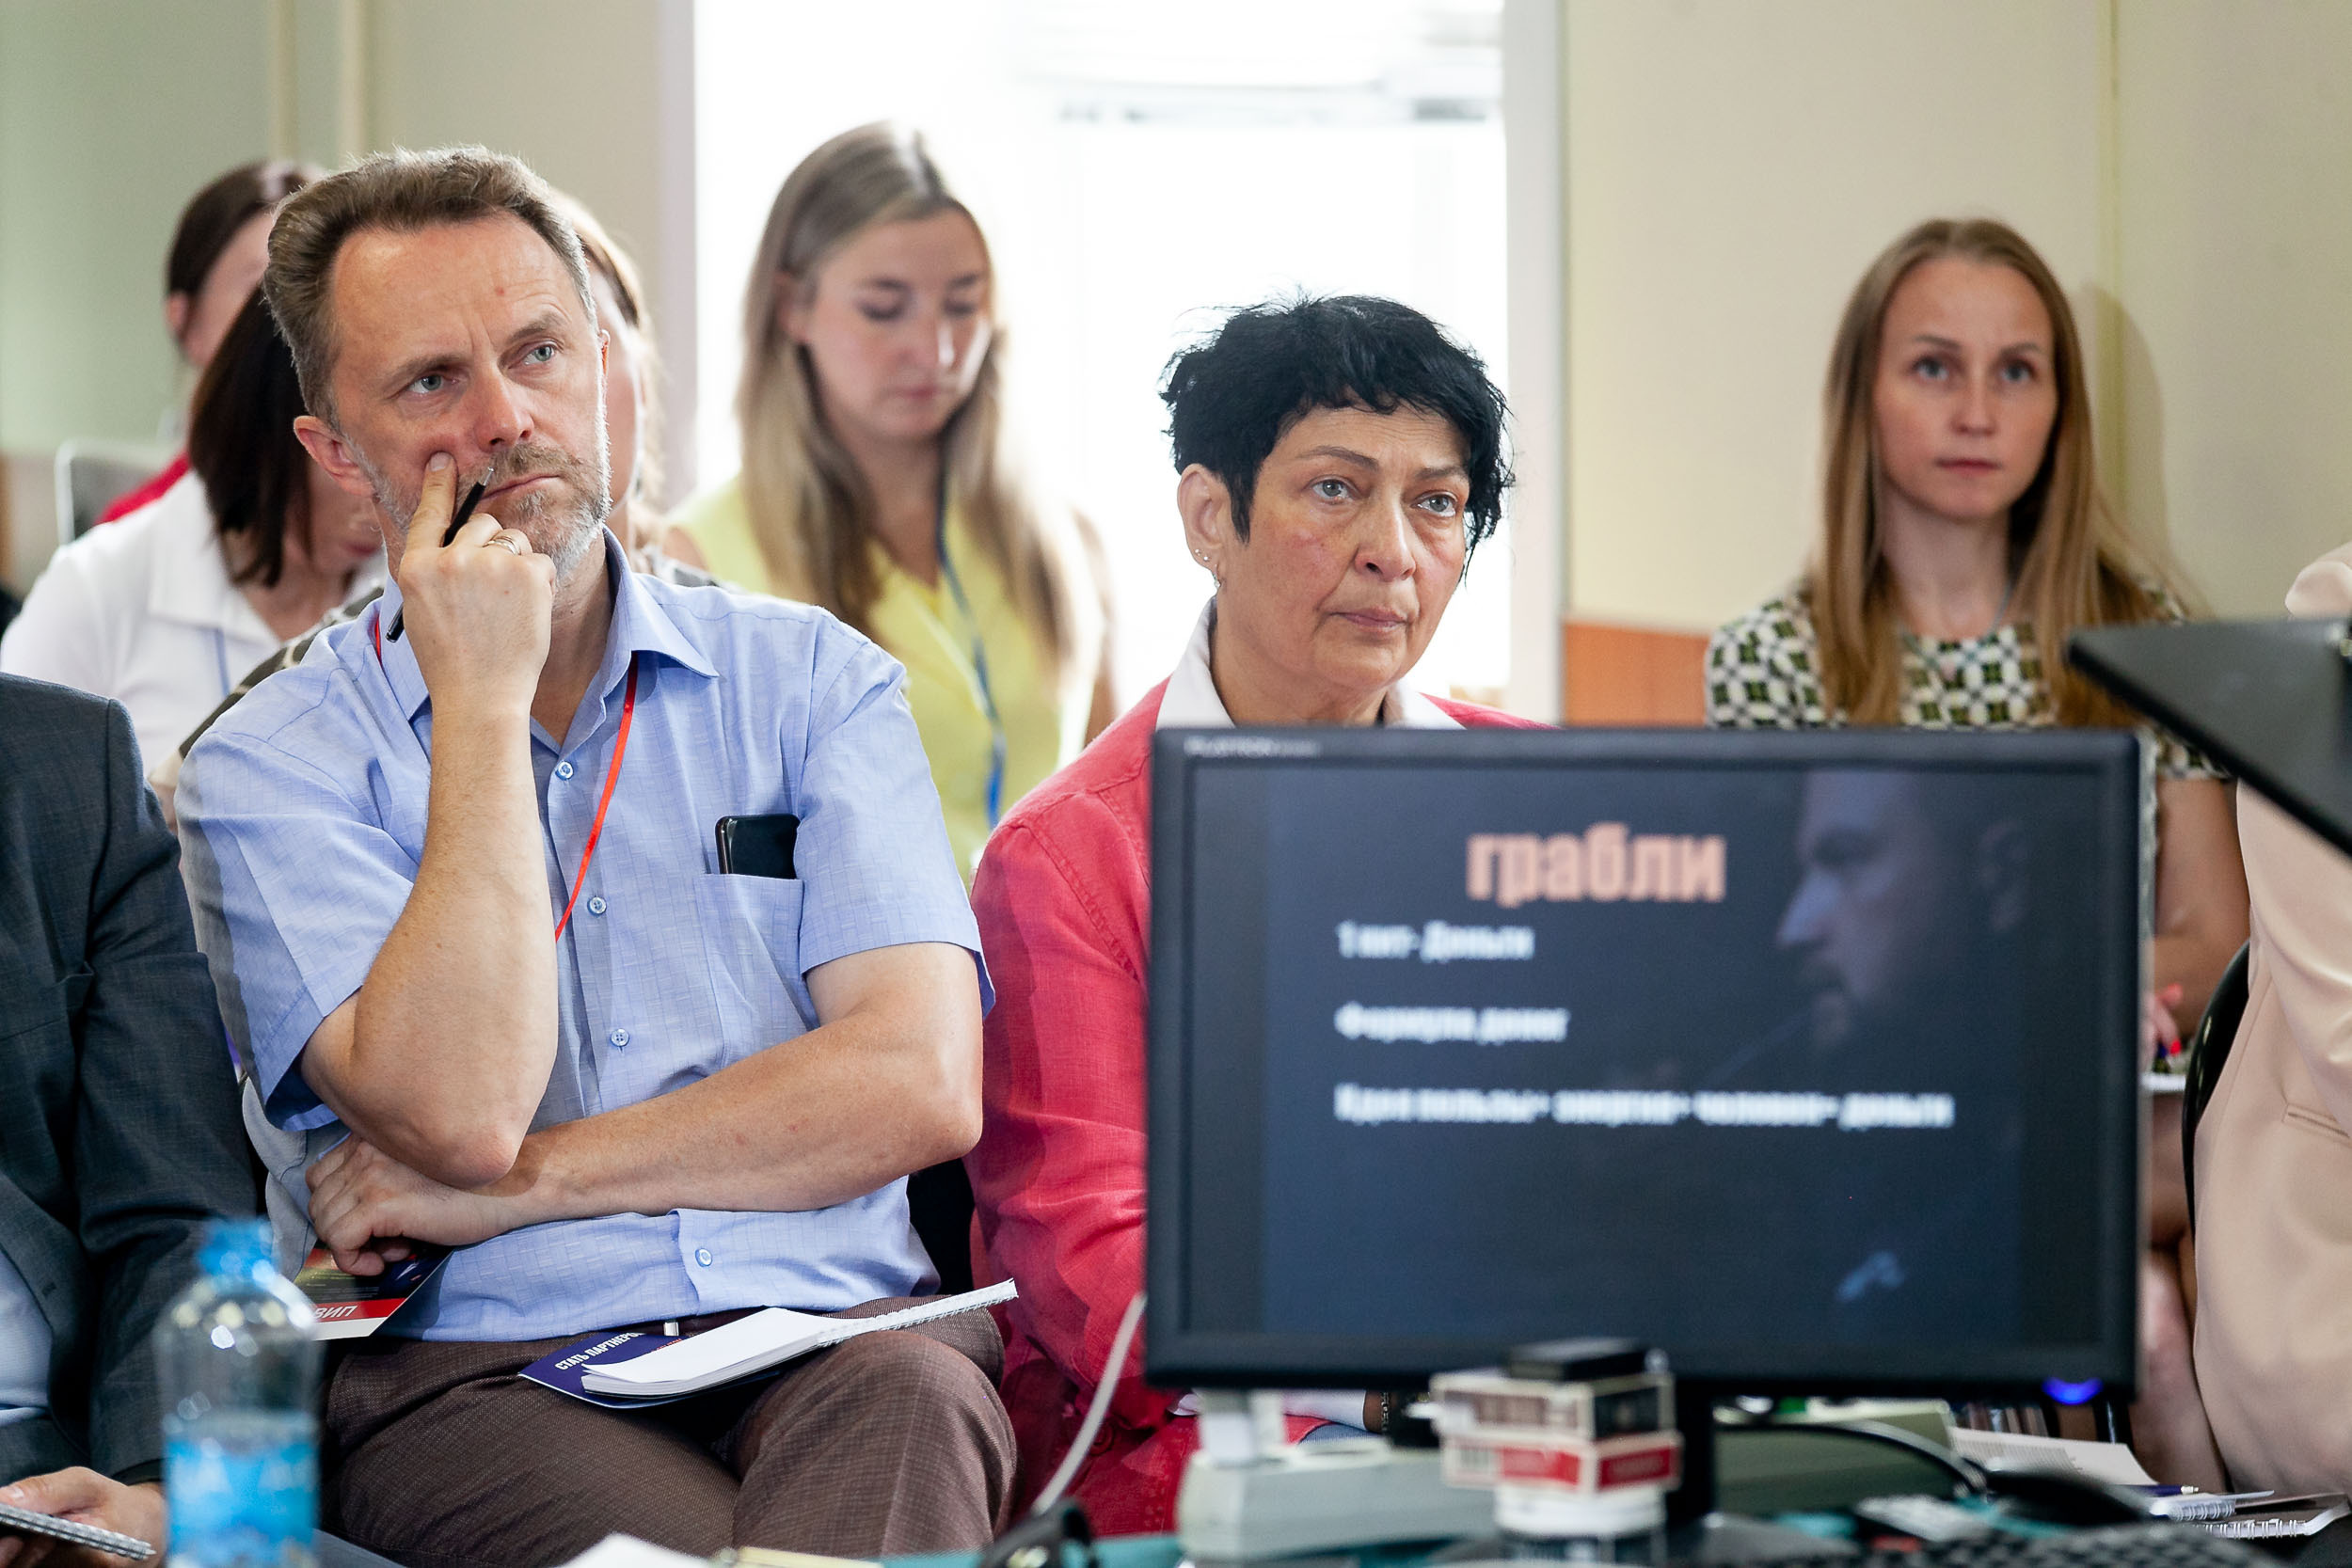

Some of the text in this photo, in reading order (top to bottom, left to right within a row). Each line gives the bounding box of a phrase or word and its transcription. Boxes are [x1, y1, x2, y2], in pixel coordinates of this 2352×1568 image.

[1467, 822, 1725, 908] грабли
[1334, 1002, 1476, 1044] Формула
[554, 1352, 590, 1370] СТАТЬ
[584, 1332, 646, 1358] ПАРТНЕРО
